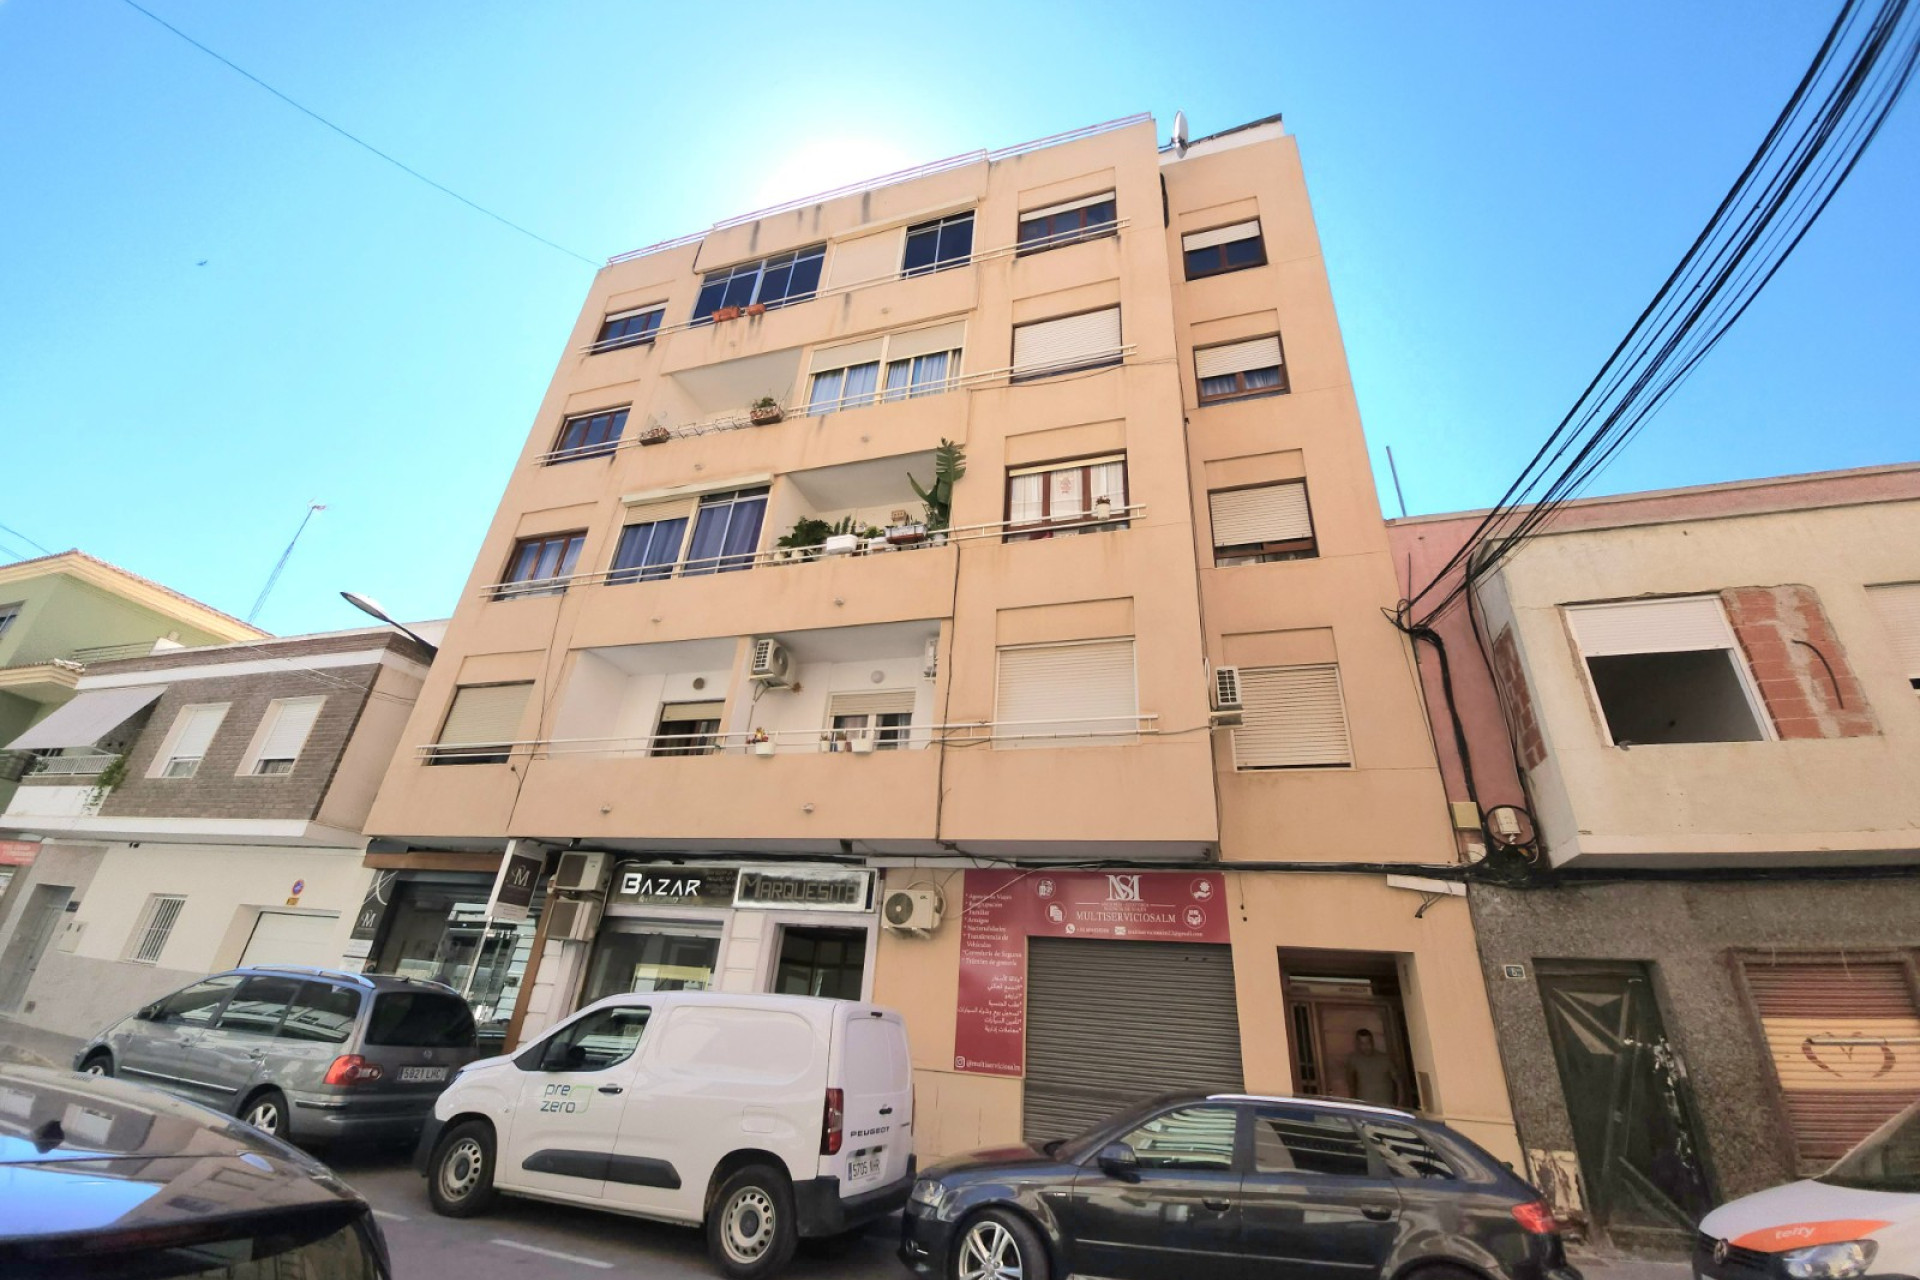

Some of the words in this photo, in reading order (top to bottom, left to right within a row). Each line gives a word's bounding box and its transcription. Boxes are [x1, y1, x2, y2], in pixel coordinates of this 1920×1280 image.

[620, 873, 701, 896] BAZAR
[740, 873, 859, 901] MARQUESITA
[1076, 911, 1176, 923] MULTISERVICIOSALM
[544, 1084, 571, 1098] pre
[540, 1100, 576, 1113] zero
[850, 1126, 890, 1137] PEUGEOT
